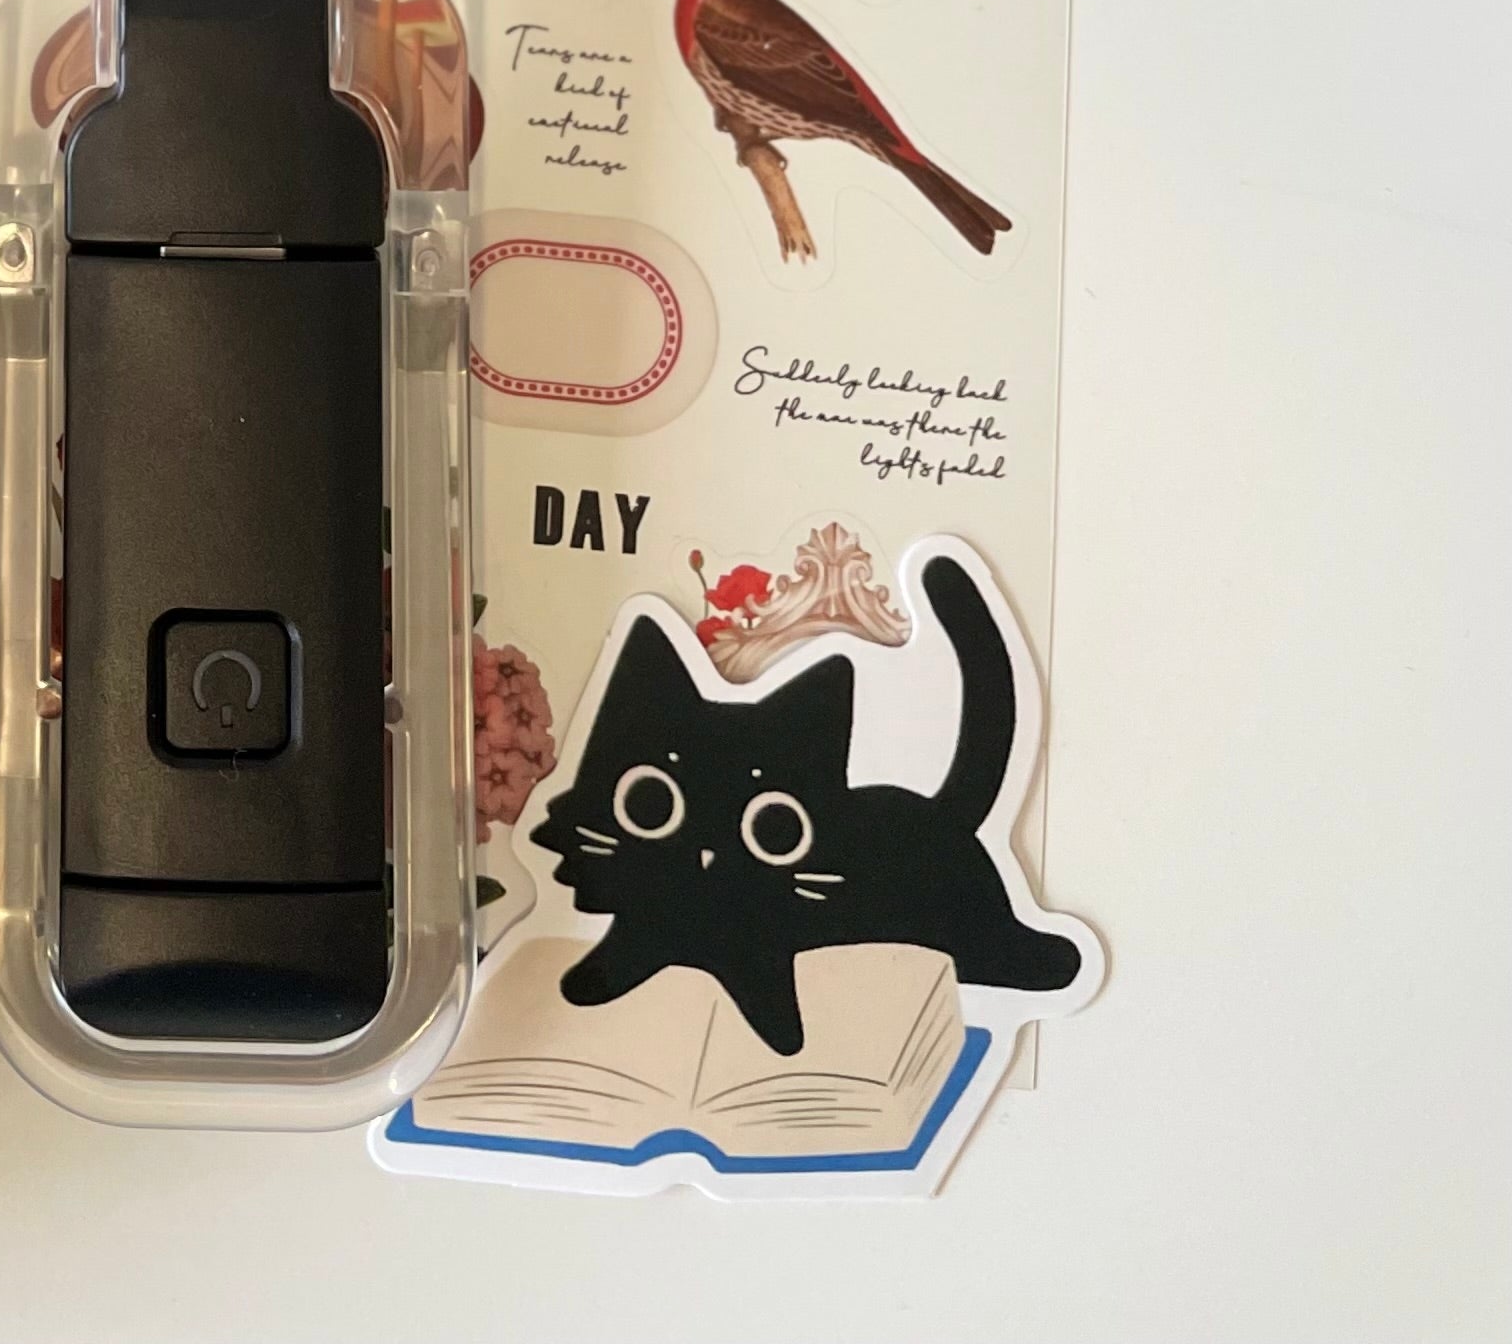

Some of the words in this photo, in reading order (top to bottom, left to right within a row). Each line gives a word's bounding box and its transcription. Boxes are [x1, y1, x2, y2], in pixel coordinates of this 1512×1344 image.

[505, 24, 575, 72] Tears
[618, 54, 633, 64] a
[608, 86, 632, 111] of
[544, 144, 628, 176] release
[734, 345, 863, 400] Suddenly
[866, 367, 953, 409] looking
[955, 375, 1009, 402] back
[774, 396, 814, 428] the
[968, 416, 1008, 447] the
[532, 484, 652, 555] DAY
